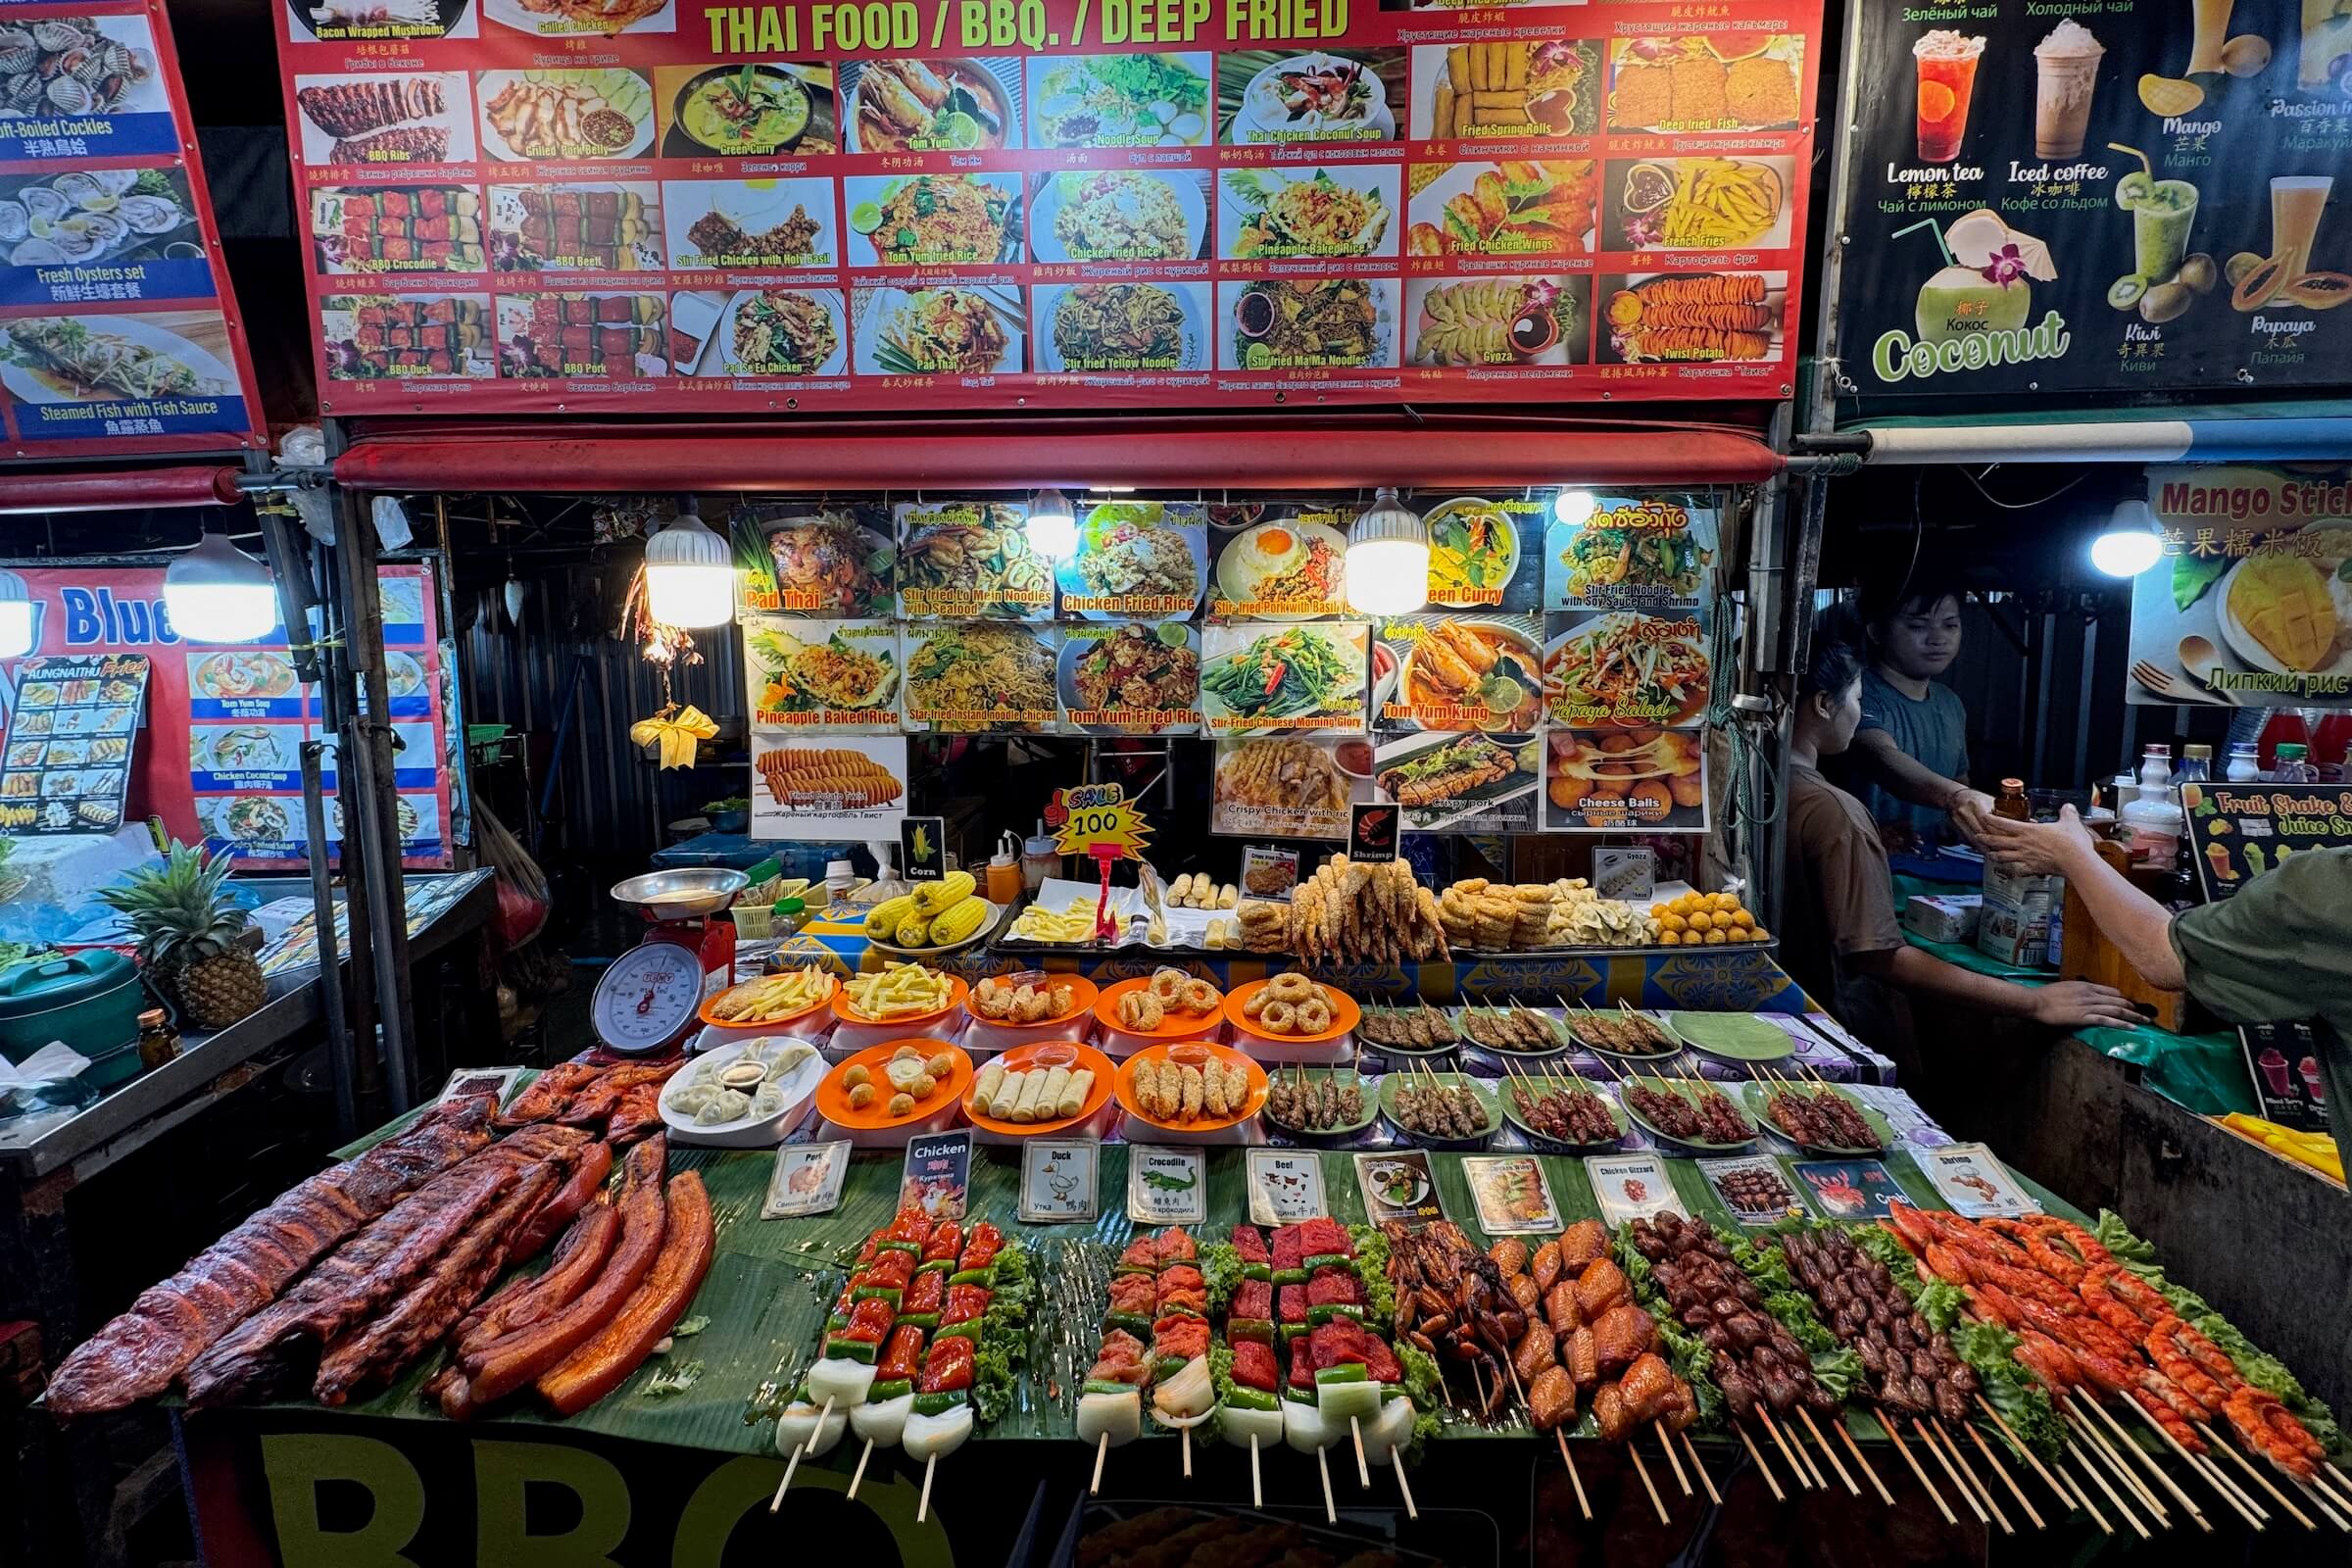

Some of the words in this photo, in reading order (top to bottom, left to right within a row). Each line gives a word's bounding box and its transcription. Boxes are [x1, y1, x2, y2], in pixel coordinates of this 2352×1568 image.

[1902, 7, 1967, 22] Зелёный
[1971, 5, 1997, 19] чай
[2026, 1, 2102, 17] Холодный
[2107, 0, 2133, 13] чай
[317, 25, 347, 38] Bacon
[349, 25, 390, 38] Wrapped
[392, 24, 445, 36] Mushrooms
[538, 22, 569, 33] Grilled
[571, 21, 609, 32] Chicken
[705, 3, 798, 54] THAI
[813, 1, 919, 50] FOOD
[961, 0, 1060, 51] BBQ.
[1102, 0, 1209, 45] DEEP
[1226, 0, 1348, 41] FRIED
[2271, 99, 2336, 118] Passion
[60, 119, 113, 135] Cockles
[1462, 124, 1488, 137] Fried
[1489, 123, 1524, 137] Spring
[1527, 122, 1552, 135] Rolls
[2163, 118, 2223, 136] Mango
[1247, 130, 1271, 143] Thai
[1273, 129, 1311, 141] Chicken
[1314, 129, 1353, 141] Coconut
[1356, 128, 1381, 141] Soup
[720, 143, 748, 156] Green
[751, 143, 775, 156] Curry
[908, 138, 927, 150] Tom
[930, 137, 951, 149] Yum
[368, 151, 388, 162] BBQ
[391, 150, 410, 161] Ribs
[2165, 155, 2211, 167] Манго
[1887, 163, 1950, 183] Lemon
[1952, 163, 1984, 182] tea
[2008, 162, 2049, 181] Iced
[2053, 162, 2109, 180] coffee
[1878, 200, 1905, 214] Чай
[1919, 199, 1986, 212] лимоном
[2001, 197, 2036, 212] Кофе
[2040, 199, 2056, 210] со
[2058, 197, 2109, 212] льдом
[1451, 240, 1477, 252] Fried
[1479, 239, 1520, 251] Chicken
[1522, 238, 1553, 251] Wings
[1664, 237, 1697, 247] French
[1700, 235, 1725, 247] Fries
[1258, 243, 1306, 256] Pineapple
[1309, 243, 1341, 254] Baked
[1343, 242, 1364, 254] Rice
[372, 259, 391, 270] BBQ
[393, 258, 437, 269] Crocodile
[1664, 254, 1730, 266] Картофель
[1733, 254, 1758, 266] фри
[37, 268, 72, 284] Fresh
[74, 267, 122, 282] Oysters
[124, 266, 146, 280] set
[1946, 318, 1988, 331] Кокос
[2251, 316, 2316, 335] Papaya
[2125, 323, 2161, 342] Kiwi
[1873, 310, 2070, 382] Coconut
[1484, 351, 1513, 363] Gyoza
[1665, 348, 1691, 359] Twist
[1693, 348, 1724, 359] Potato
[564, 363, 583, 373] BBQ
[585, 363, 607, 373] Pork
[917, 360, 936, 370] Pad
[937, 359, 956, 369] Thai
[1064, 357, 1082, 368] Stir
[1108, 355, 1141, 368] Yellow
[1143, 355, 1180, 367] Noodles
[2121, 359, 2155, 372] Киви
[1679, 367, 1732, 378] Картошка
[40, 404, 95, 421] Steamed
[97, 405, 122, 418] Fish
[125, 403, 151, 417] with
[153, 402, 178, 416] Fish
[180, 401, 219, 415] Sauce
[2161, 482, 2271, 521] Mango
[2162, 527, 2325, 558] 芒果糯米饭
[904, 589, 925, 602] Stir
[956, 590, 970, 602] Lo
[1004, 590, 1052, 603] Noodles
[1635, 585, 1675, 594] Noodles
[745, 589, 780, 610] Pad
[783, 590, 820, 611] Thai
[1062, 596, 1119, 612] Chicken
[1124, 596, 1159, 612] Fried
[1164, 596, 1195, 611] Rice
[1461, 588, 1502, 606] Curry
[1561, 597, 1583, 606] with
[1586, 597, 1602, 607] Soy
[1606, 597, 1638, 606] Sauce
[1641, 597, 1658, 606] and
[1662, 597, 1698, 607] Shrimp
[904, 604, 929, 615] with
[931, 604, 978, 615] Seafood
[2206, 667, 2298, 691] Липкий
[2305, 674, 2348, 698] рис
[757, 710, 820, 725] Pineapple
[824, 710, 864, 724] Baked
[869, 710, 898, 724] Rice
[1067, 710, 1098, 725] Tom
[1101, 710, 1134, 723] Yum
[1137, 710, 1172, 724] Fried
[1177, 710, 1200, 723] Ric
[1383, 703, 1414, 720] Tom
[1417, 704, 1449, 720] Yum
[1451, 704, 1490, 722] Kung
[1550, 697, 1611, 726] Papaya
[1614, 696, 1671, 719] Salad
[1256, 718, 1295, 727] Chinese
[1297, 718, 1335, 730] Morning
[1338, 718, 1360, 729] Glory
[1068, 783, 1122, 809] SALE
[1579, 798, 1625, 807] Cheese
[1629, 798, 1660, 808] Balls
[2216, 792, 2271, 814] Fruit
[2272, 794, 2336, 814] Shake
[1228, 805, 1264, 815] Crispy
[1265, 807, 1308, 815] Chicken
[1310, 808, 1332, 816] with
[1432, 799, 1470, 809] Crispy
[1074, 813, 1118, 835] 100
[2278, 814, 2328, 835] Juice
[1353, 851, 1393, 860] Shrimp
[914, 1144, 966, 1158] Chicken
[1052, 1151, 1071, 1161] Duck
[1149, 1157, 1186, 1166] Crocodile
[1599, 1166, 1628, 1175] Chicken
